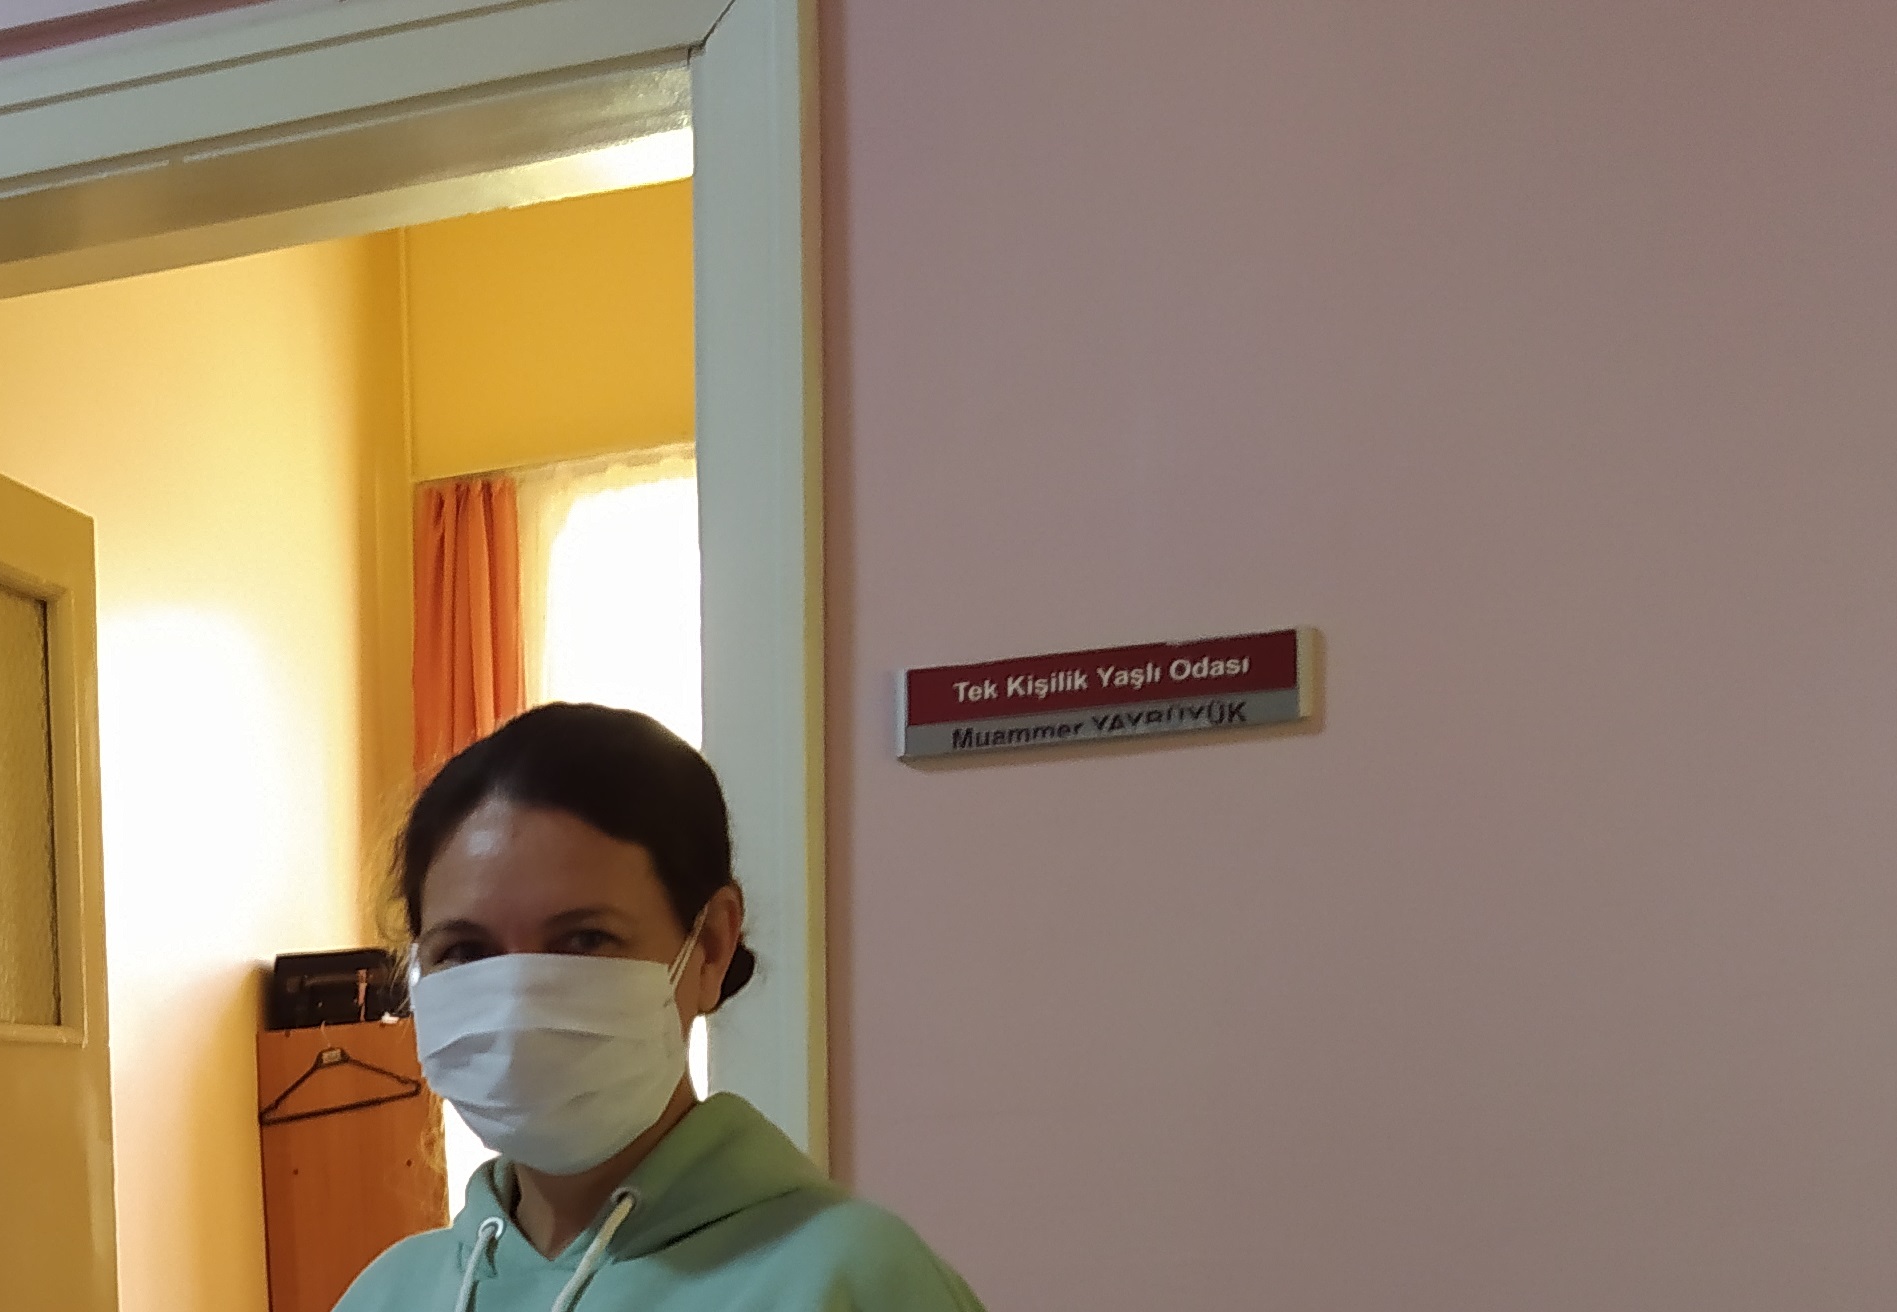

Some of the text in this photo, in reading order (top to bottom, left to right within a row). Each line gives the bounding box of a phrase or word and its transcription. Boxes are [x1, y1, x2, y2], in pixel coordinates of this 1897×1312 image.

[953, 655, 1251, 703] Tek Kişilik Yaşlı Odası
[952, 721, 1084, 750] Muammer
